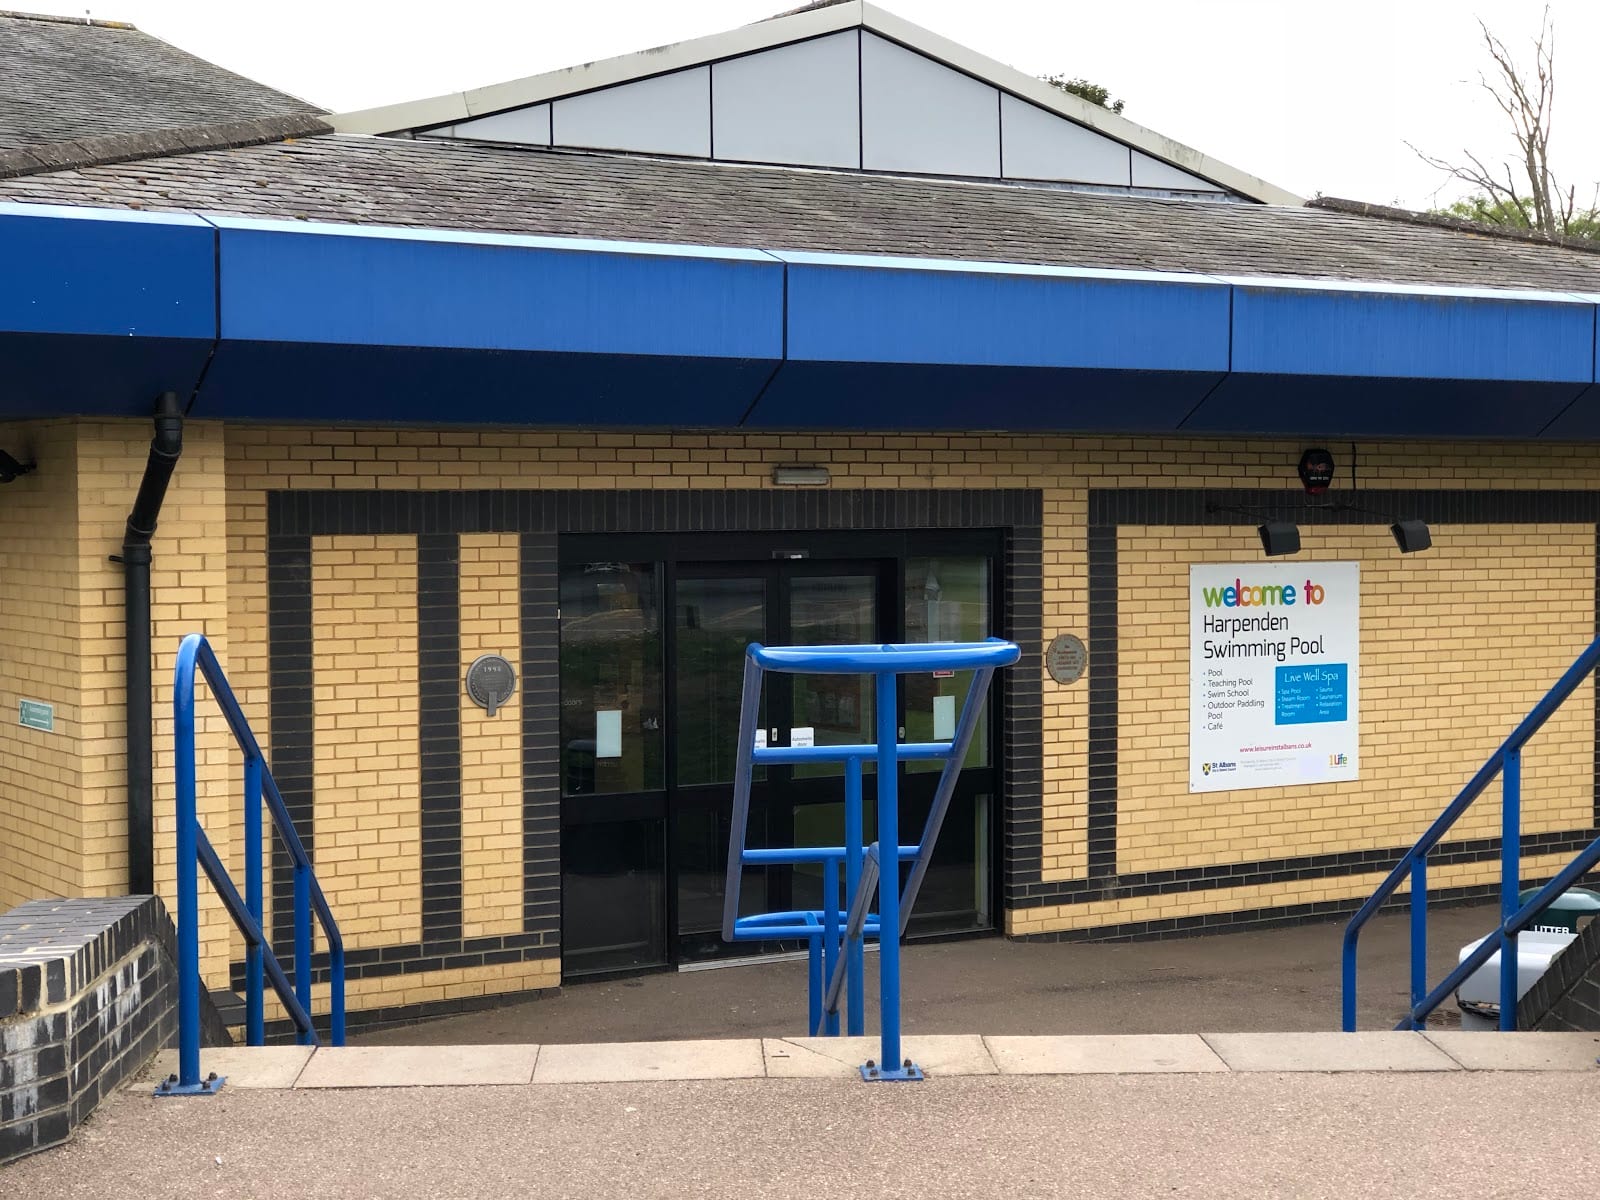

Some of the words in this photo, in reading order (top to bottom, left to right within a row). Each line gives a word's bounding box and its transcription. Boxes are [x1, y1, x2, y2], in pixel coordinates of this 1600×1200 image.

[1203, 578, 1296, 607] welcome
[1304, 579, 1325, 605] to
[1204, 611, 1288, 638] Harpenden
[1203, 639, 1286, 662] Swimming
[1290, 635, 1325, 655] Pool
[1208, 668, 1223, 677] Pool
[1284, 672, 1302, 683] Live
[1303, 668, 1320, 681] Well
[1321, 671, 1339, 686] Spa
[1208, 679, 1237, 688] Teaching
[1238, 678, 1253, 686] Pool
[1208, 690, 1226, 699] Swim
[1227, 689, 1250, 698] School
[1208, 701, 1236, 710] Outdoor
[1237, 699, 1265, 708] Paddling
[1208, 711, 1223, 720] Pool
[1208, 722, 1223, 731] Café
[1240, 742, 1312, 752] www.leisureinstalbans.co.uk
[1534, 925, 1570, 933] LITTER
